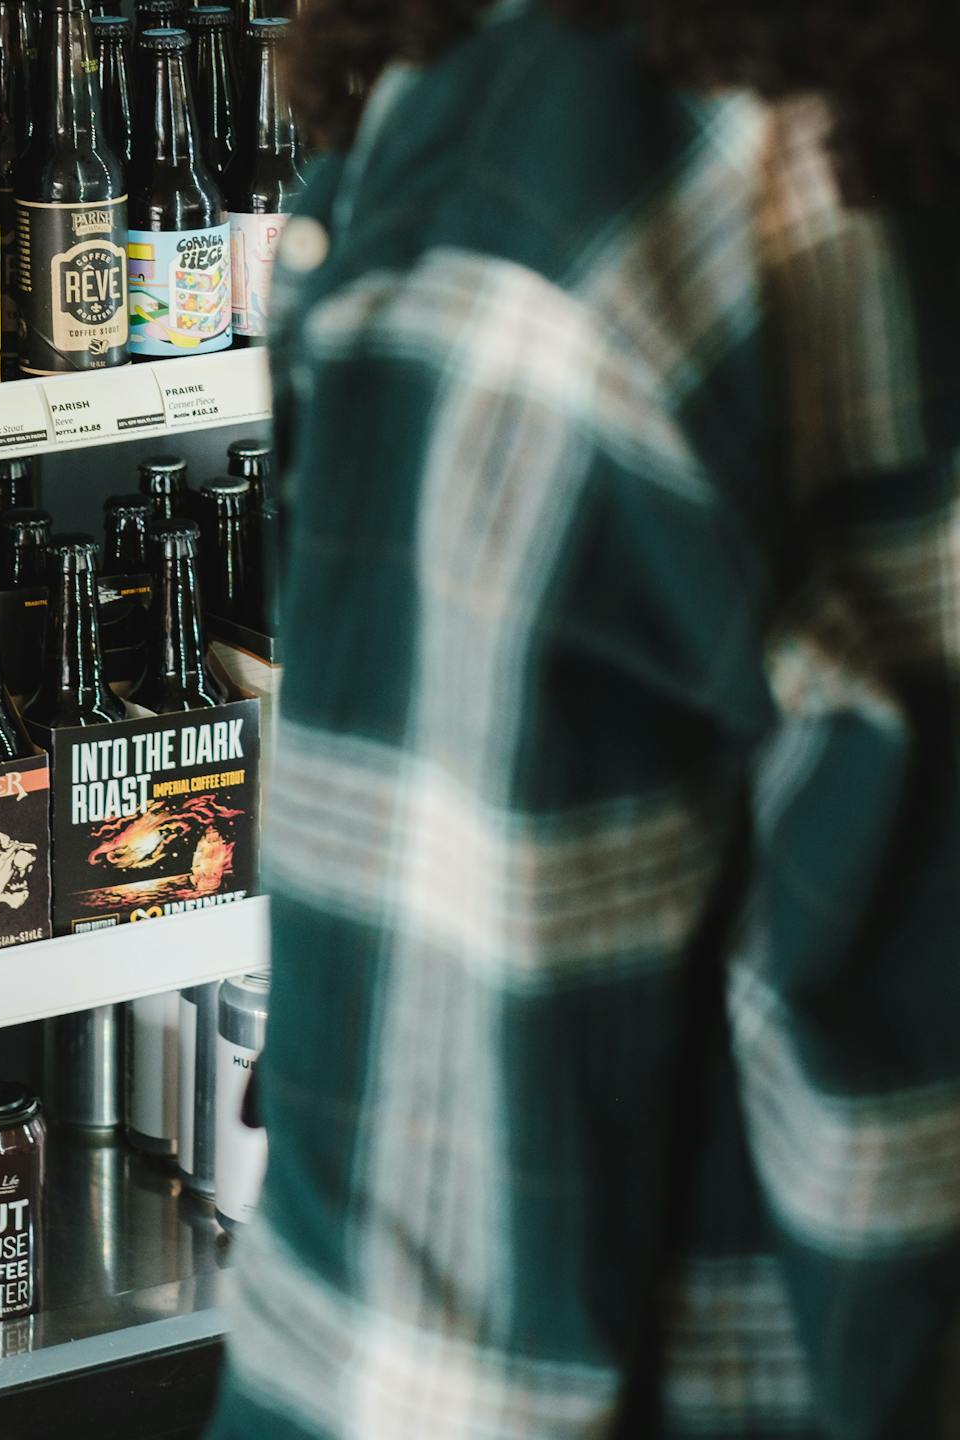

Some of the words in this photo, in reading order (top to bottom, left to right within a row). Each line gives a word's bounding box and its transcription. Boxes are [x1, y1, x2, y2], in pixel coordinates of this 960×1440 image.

[73, 210, 112, 228] PARISH
[176, 234, 224, 253] CORNER
[76, 252, 111, 267] COFFEE
[65, 264, 121, 303] RÊVE
[69, 328, 96, 338] COFFEE
[99, 325, 120, 335] STOUT
[165, 384, 205, 397] PRAIRIE
[51, 400, 90, 413] PARISH
[168, 398, 194, 410] Corner
[195, 396, 216, 407] Piece
[3, 423, 24, 434] Stout
[55, 417, 74, 427] Reve
[72, 737, 128, 784] INTO
[132, 729, 176, 775] THE
[181, 718, 244, 767] DARK
[153, 779, 191, 799] IMPERIAL
[191, 773, 220, 792] COFFEE
[220, 769, 246, 788] STOUT
[72, 773, 152, 825] ROAST
